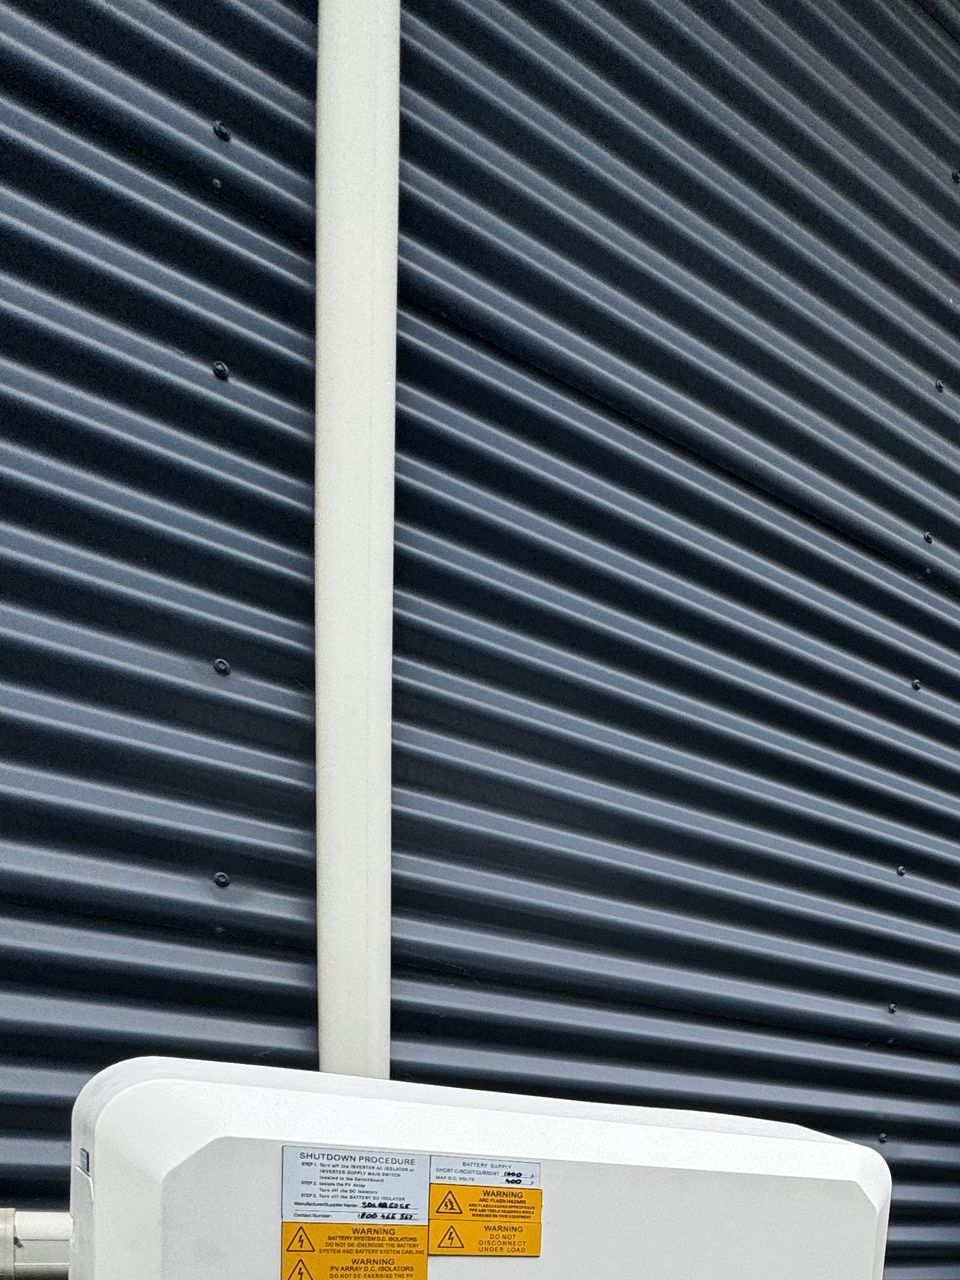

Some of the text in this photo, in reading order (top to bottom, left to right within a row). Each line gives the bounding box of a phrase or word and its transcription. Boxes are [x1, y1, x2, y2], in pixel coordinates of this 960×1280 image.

[300, 1152, 416, 1166] SHUTDOWN PROCEDURE
[482, 1190, 524, 1198] WARNING
[352, 1228, 396, 1236] WARNING
